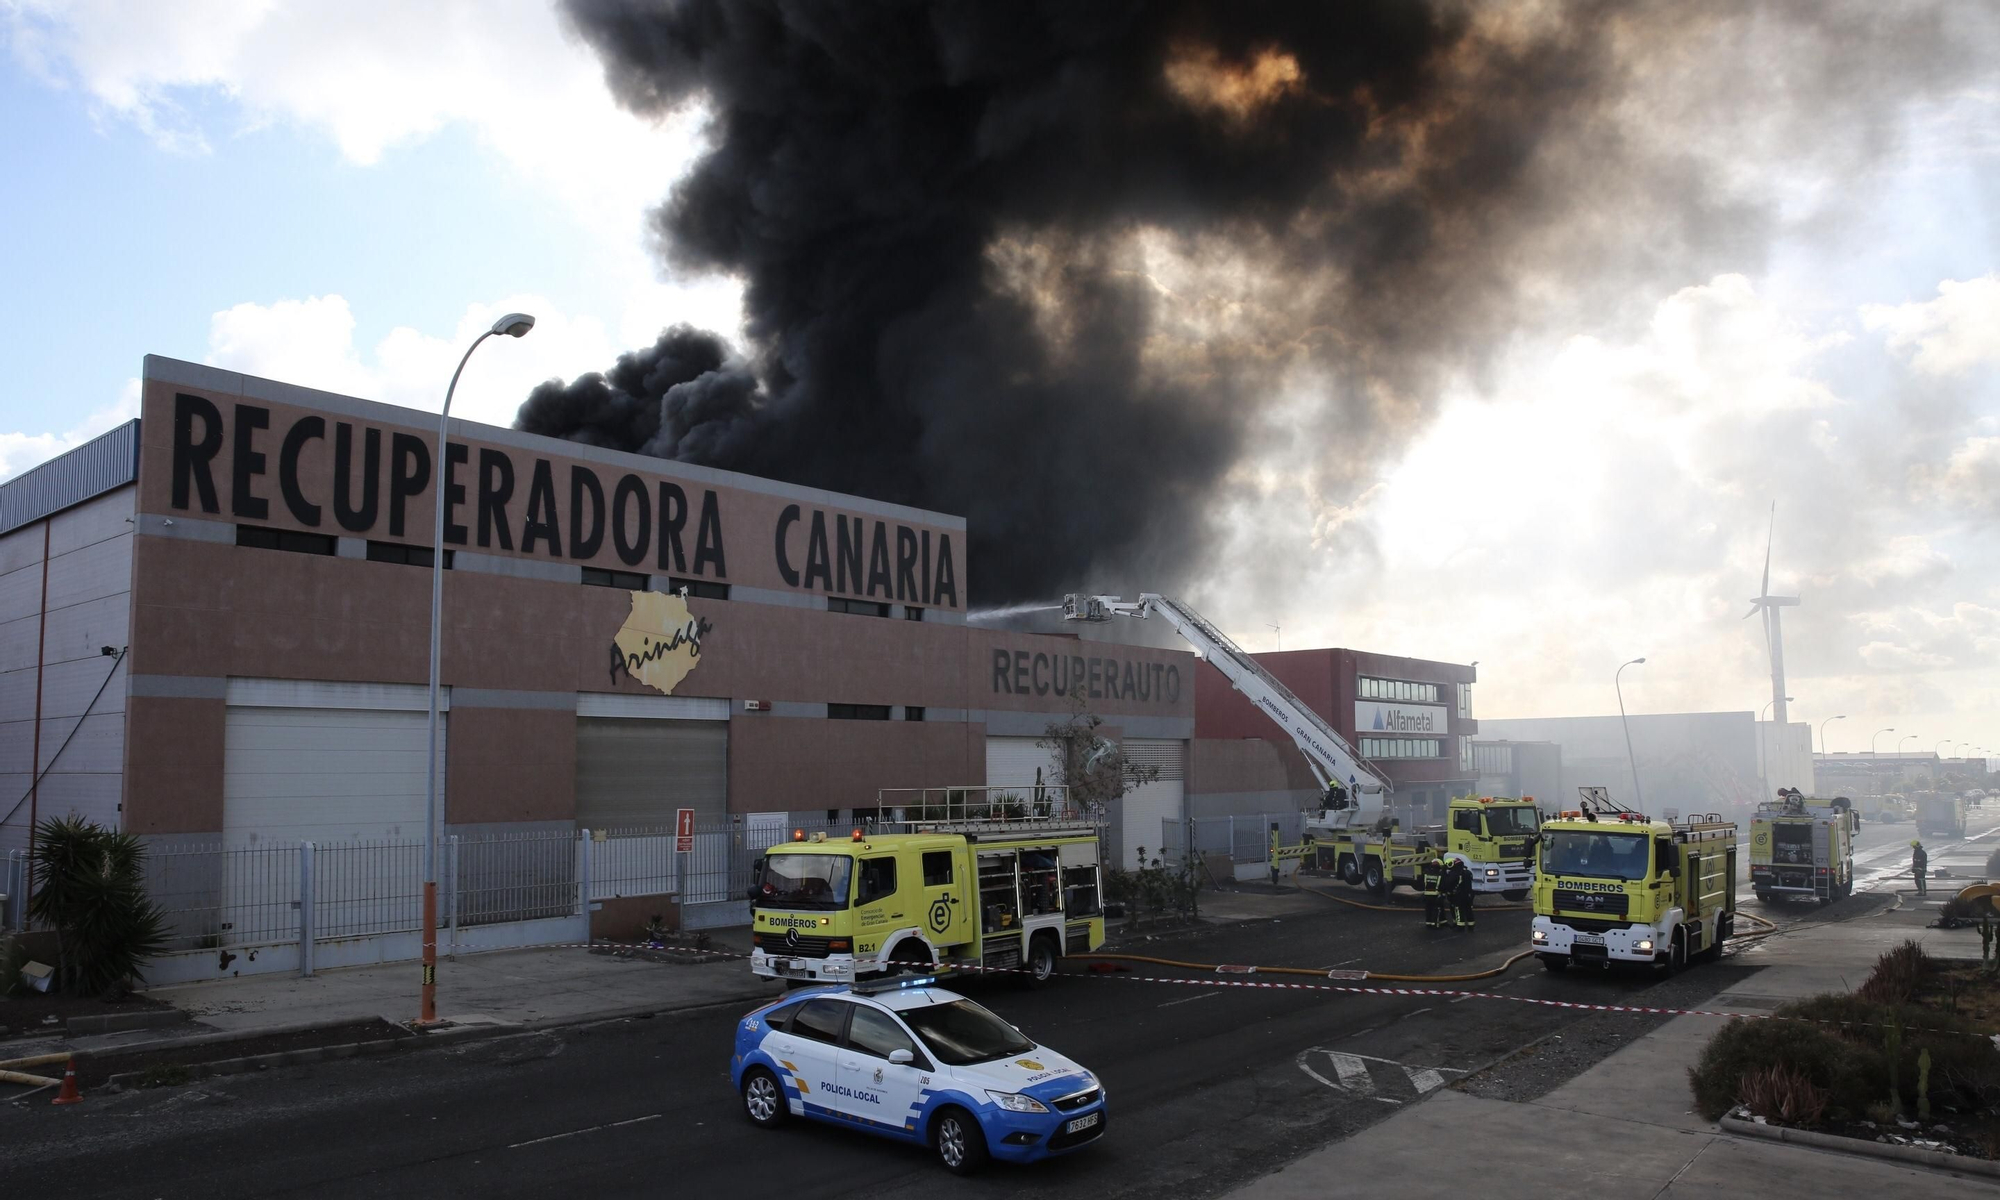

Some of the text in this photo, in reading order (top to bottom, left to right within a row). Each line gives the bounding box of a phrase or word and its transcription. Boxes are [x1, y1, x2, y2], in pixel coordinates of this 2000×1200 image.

[171, 392, 958, 608] RECUPERADORA CANARIA
[609, 617, 713, 686] Arinaga
[993, 648, 1181, 703] RECUPERAUTO
[1262, 696, 1337, 766] BOMBEROS GRAN CANARIA
[1385, 709, 1434, 732] Alfametal
[1557, 880, 1624, 893] BOMBEROS
[1575, 894, 1604, 903] MAN
[769, 917, 817, 929] BOMBEROS
[858, 943, 876, 953] B2.1
[1026, 1068, 1072, 1083] POLICIA LOCAL
[821, 1081, 852, 1098] POLICIA
[854, 1091, 881, 1104] LOCAL
